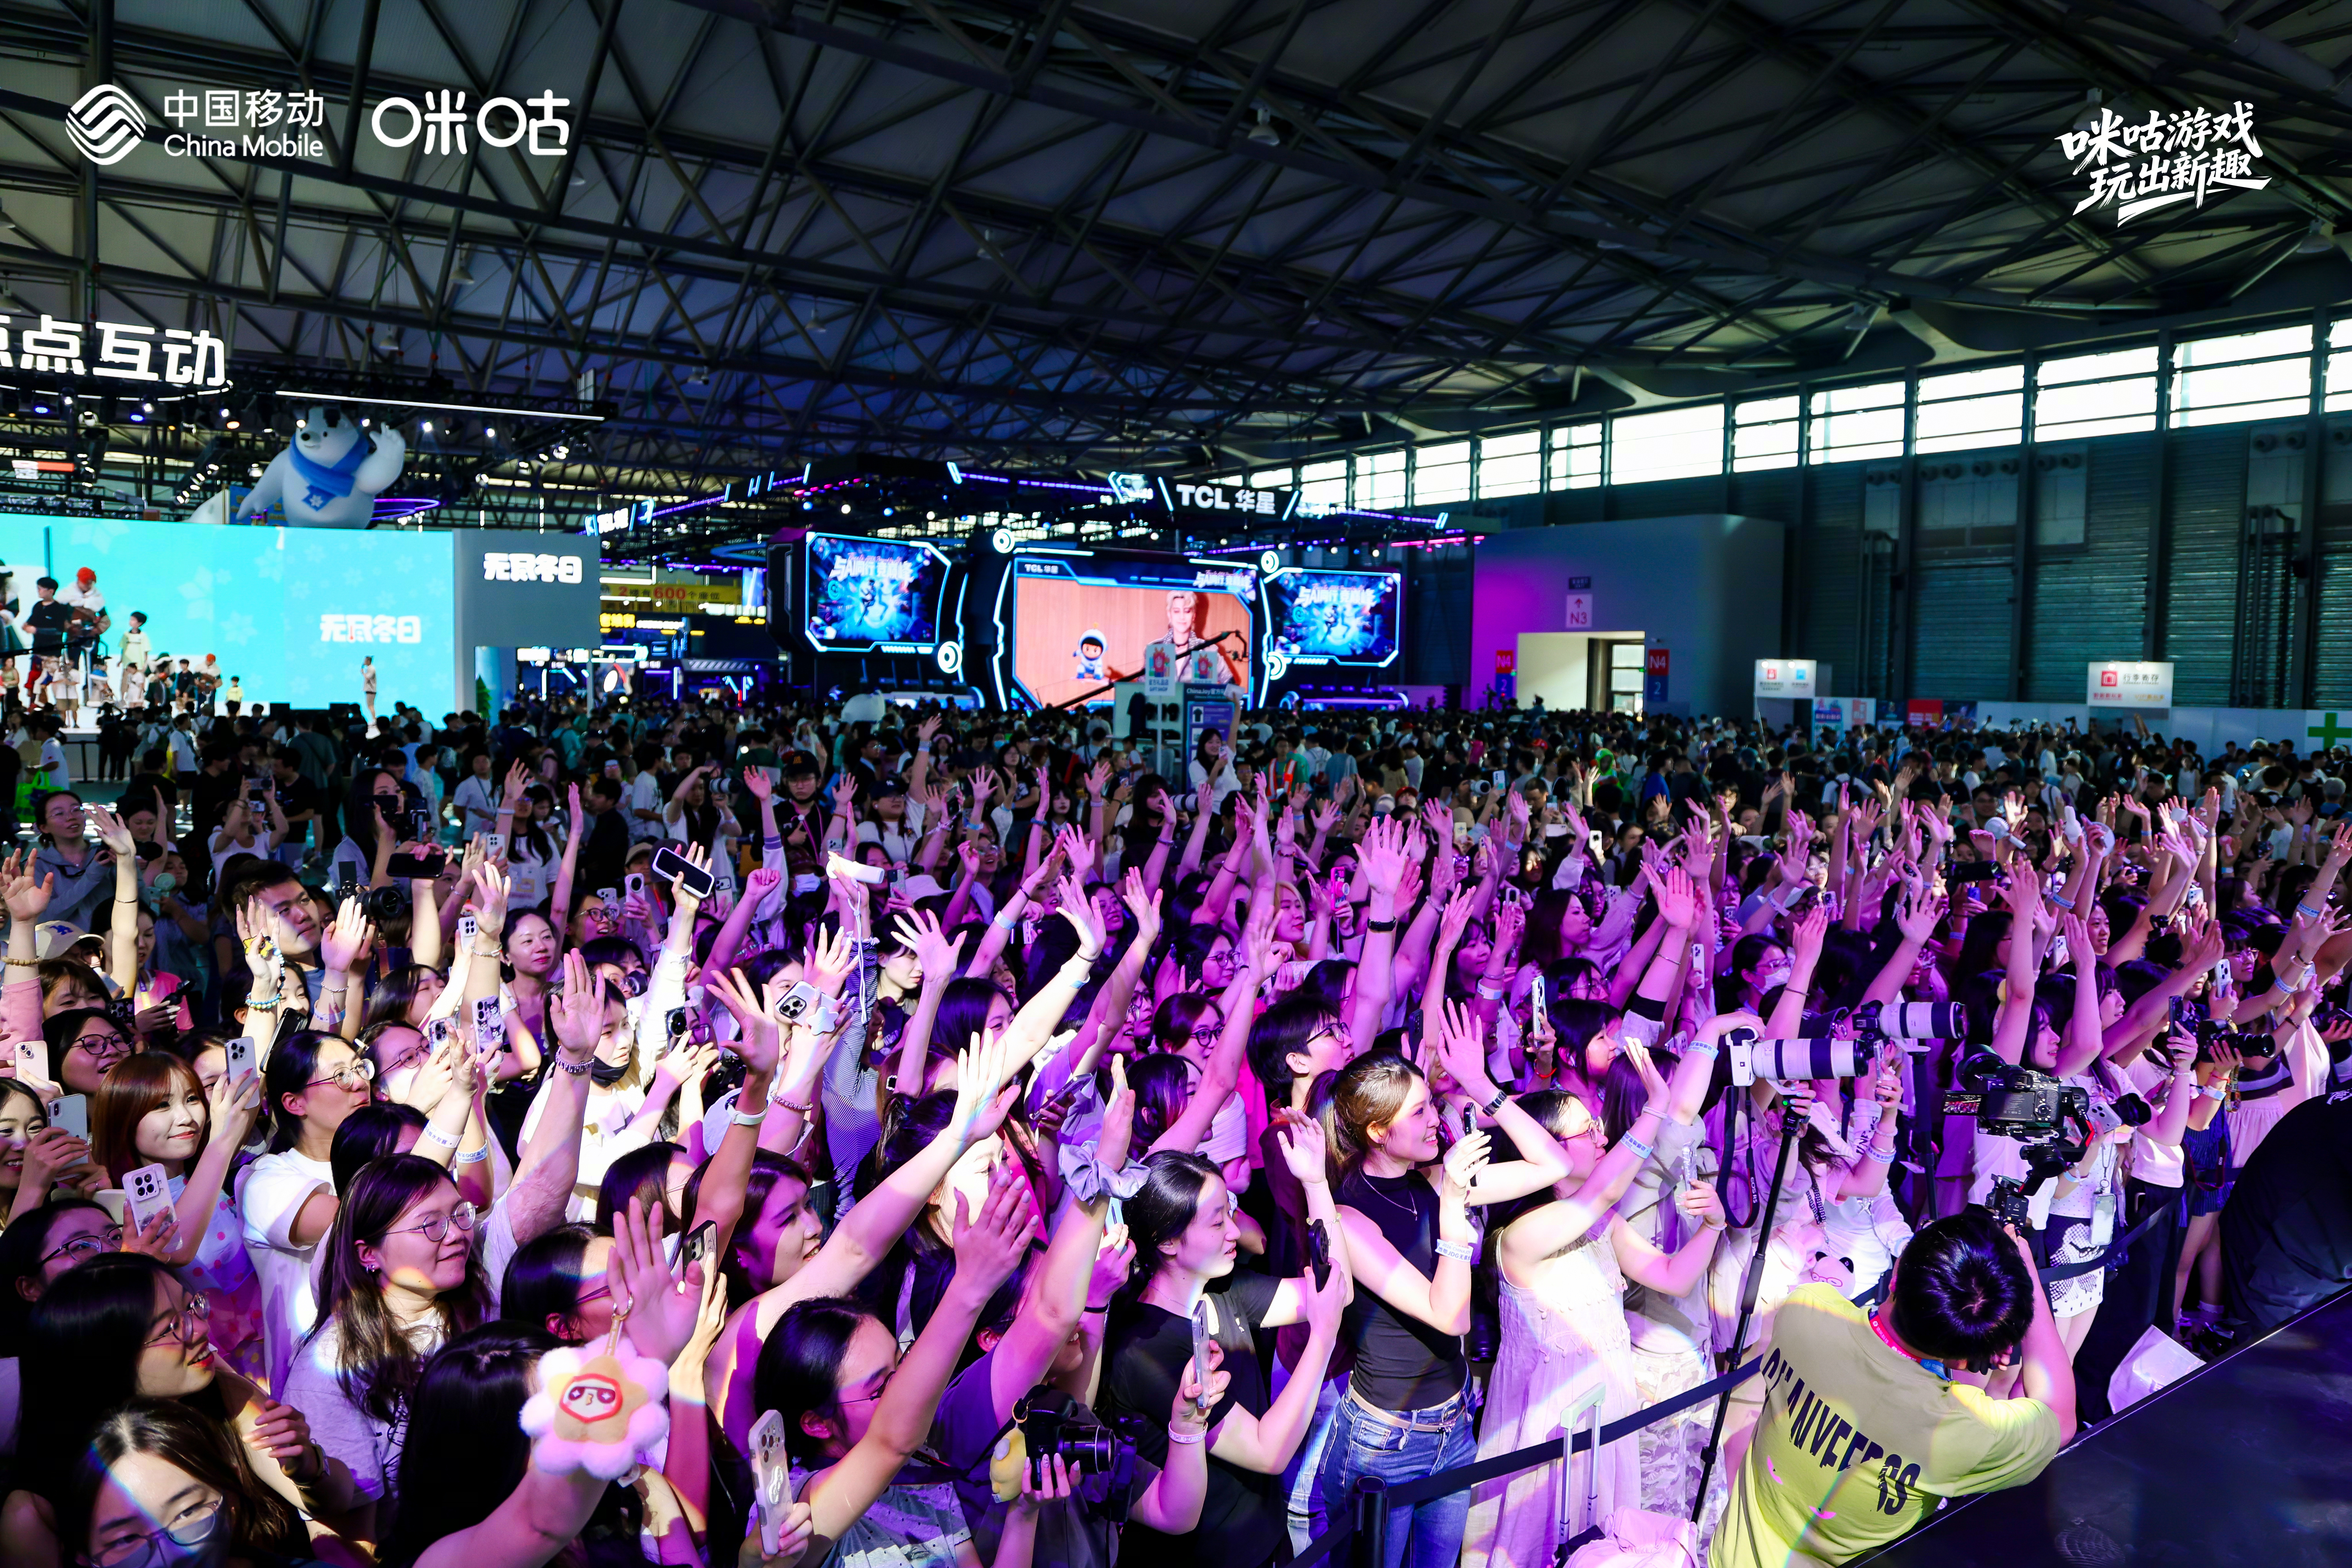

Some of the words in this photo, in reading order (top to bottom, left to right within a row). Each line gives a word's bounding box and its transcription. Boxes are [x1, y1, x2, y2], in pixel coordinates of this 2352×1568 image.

[0, 314, 226, 386] 点互动
[1176, 483, 1230, 509] TCL
[1235, 489, 1276, 515] 华星
[1024, 564, 1043, 573] TCL
[1570, 612, 1587, 625] N3
[319, 614, 421, 644] 无尽冬日
[1496, 655, 1512, 666] N4
[1649, 655, 1666, 668] N4
[1501, 679, 1508, 691] 2
[1654, 681, 1662, 695] 2
[1753, 1194, 1758, 1203] R5
